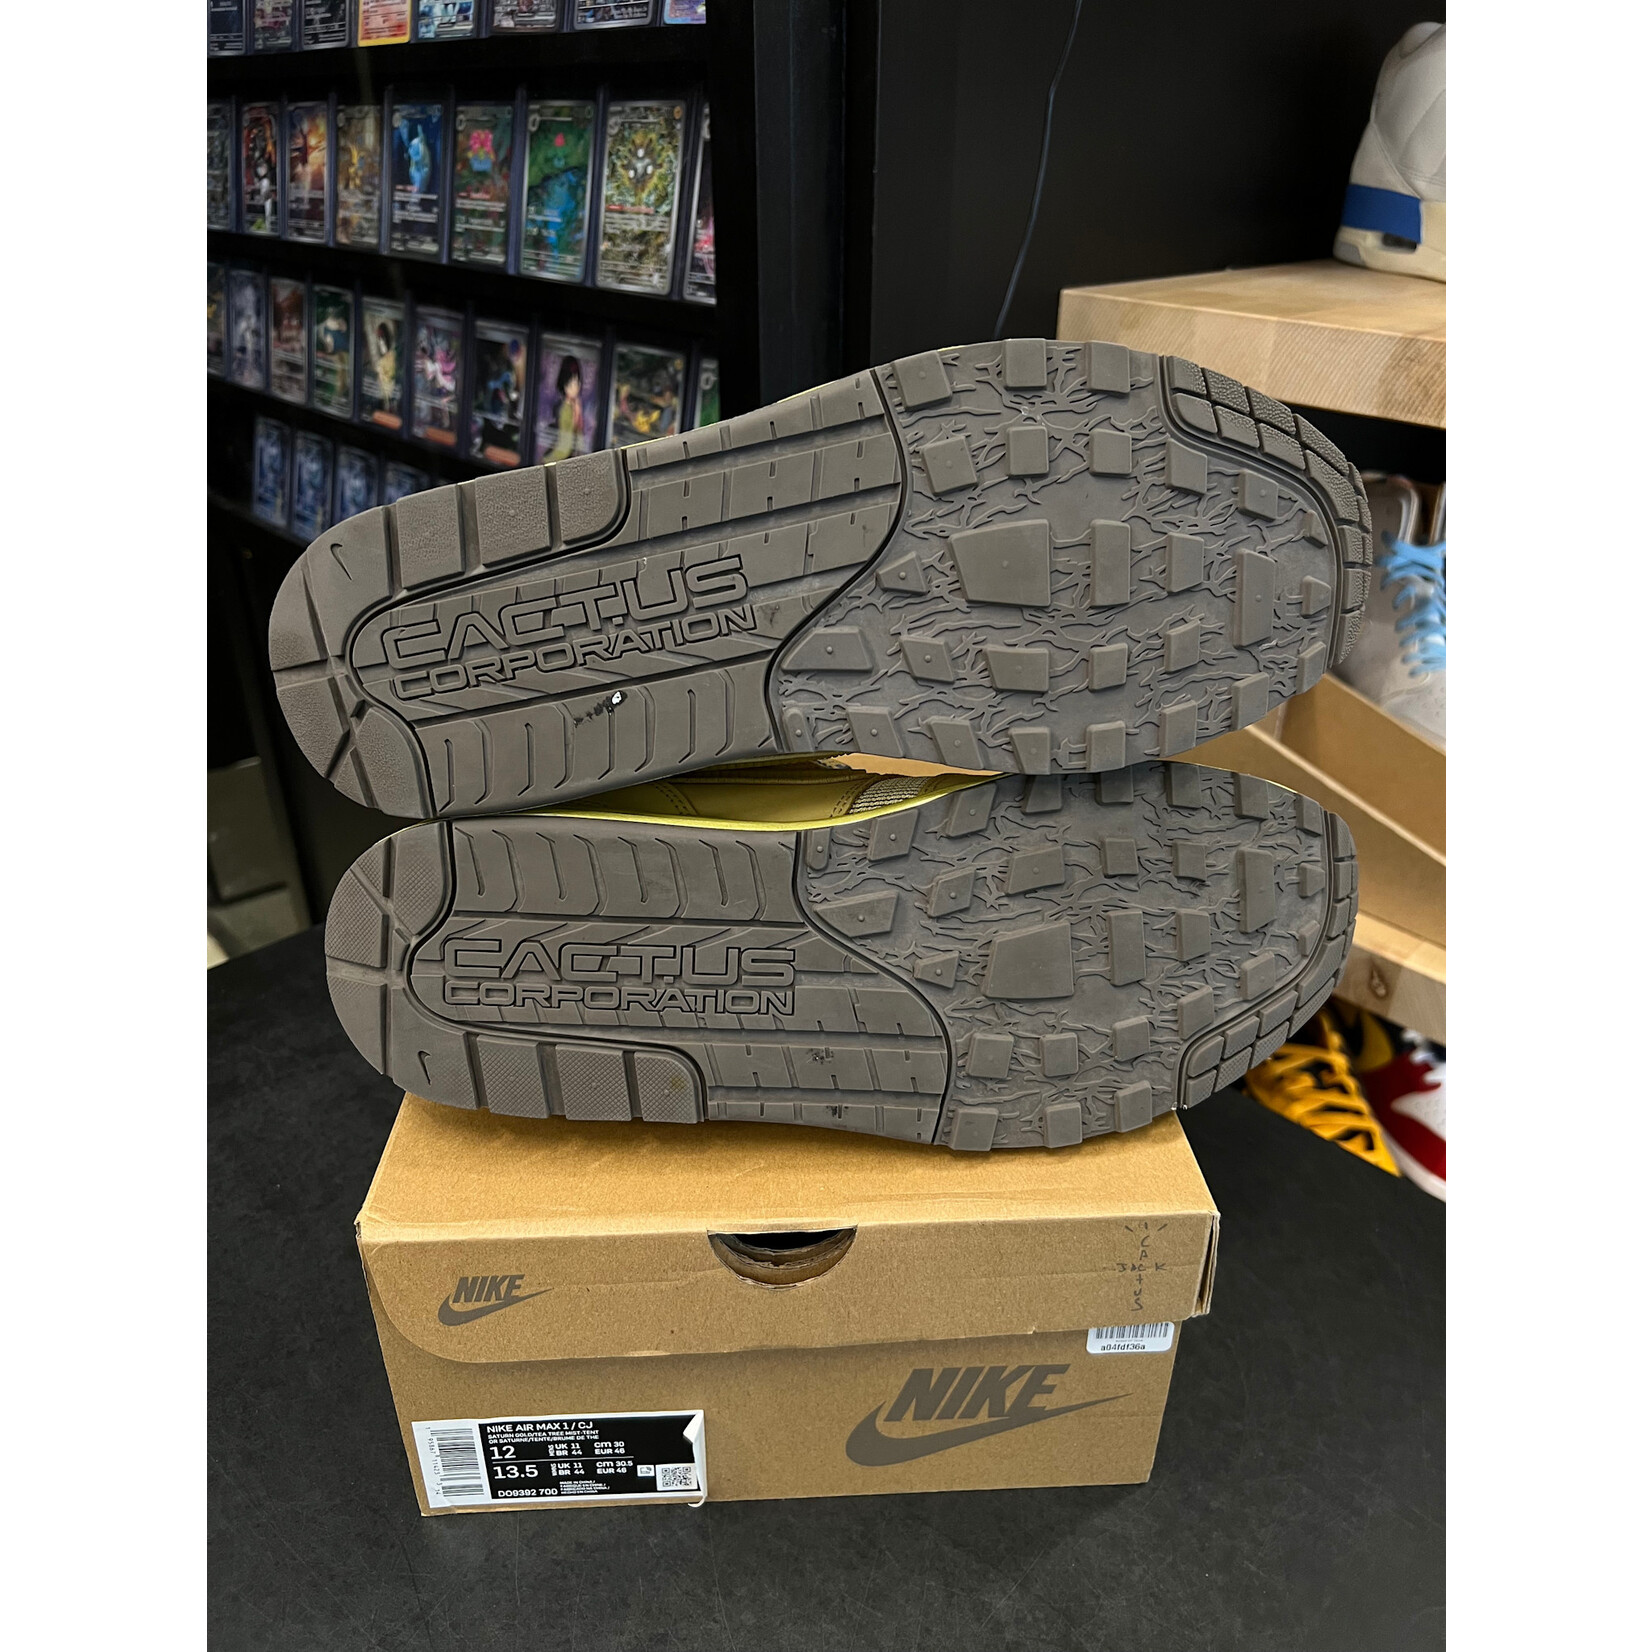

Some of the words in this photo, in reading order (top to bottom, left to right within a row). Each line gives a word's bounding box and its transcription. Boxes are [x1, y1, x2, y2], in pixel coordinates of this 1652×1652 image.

[392, 603, 757, 700] CORPORATION
[443, 981, 795, 1016] CORPORATION
[452, 1274, 525, 1303] NIKE
[883, 1363, 1071, 1422] NIKE
[486, 1424, 513, 1433] NIKE
[515, 1423, 534, 1432] AIR
[536, 1422, 561, 1431] MAX
[563, 1422, 569, 1430] 1
[578, 1421, 593, 1430] CJ
[489, 1445, 516, 1460] 12
[493, 1464, 539, 1479] 13.5
[538, 1488, 558, 1496] 700
